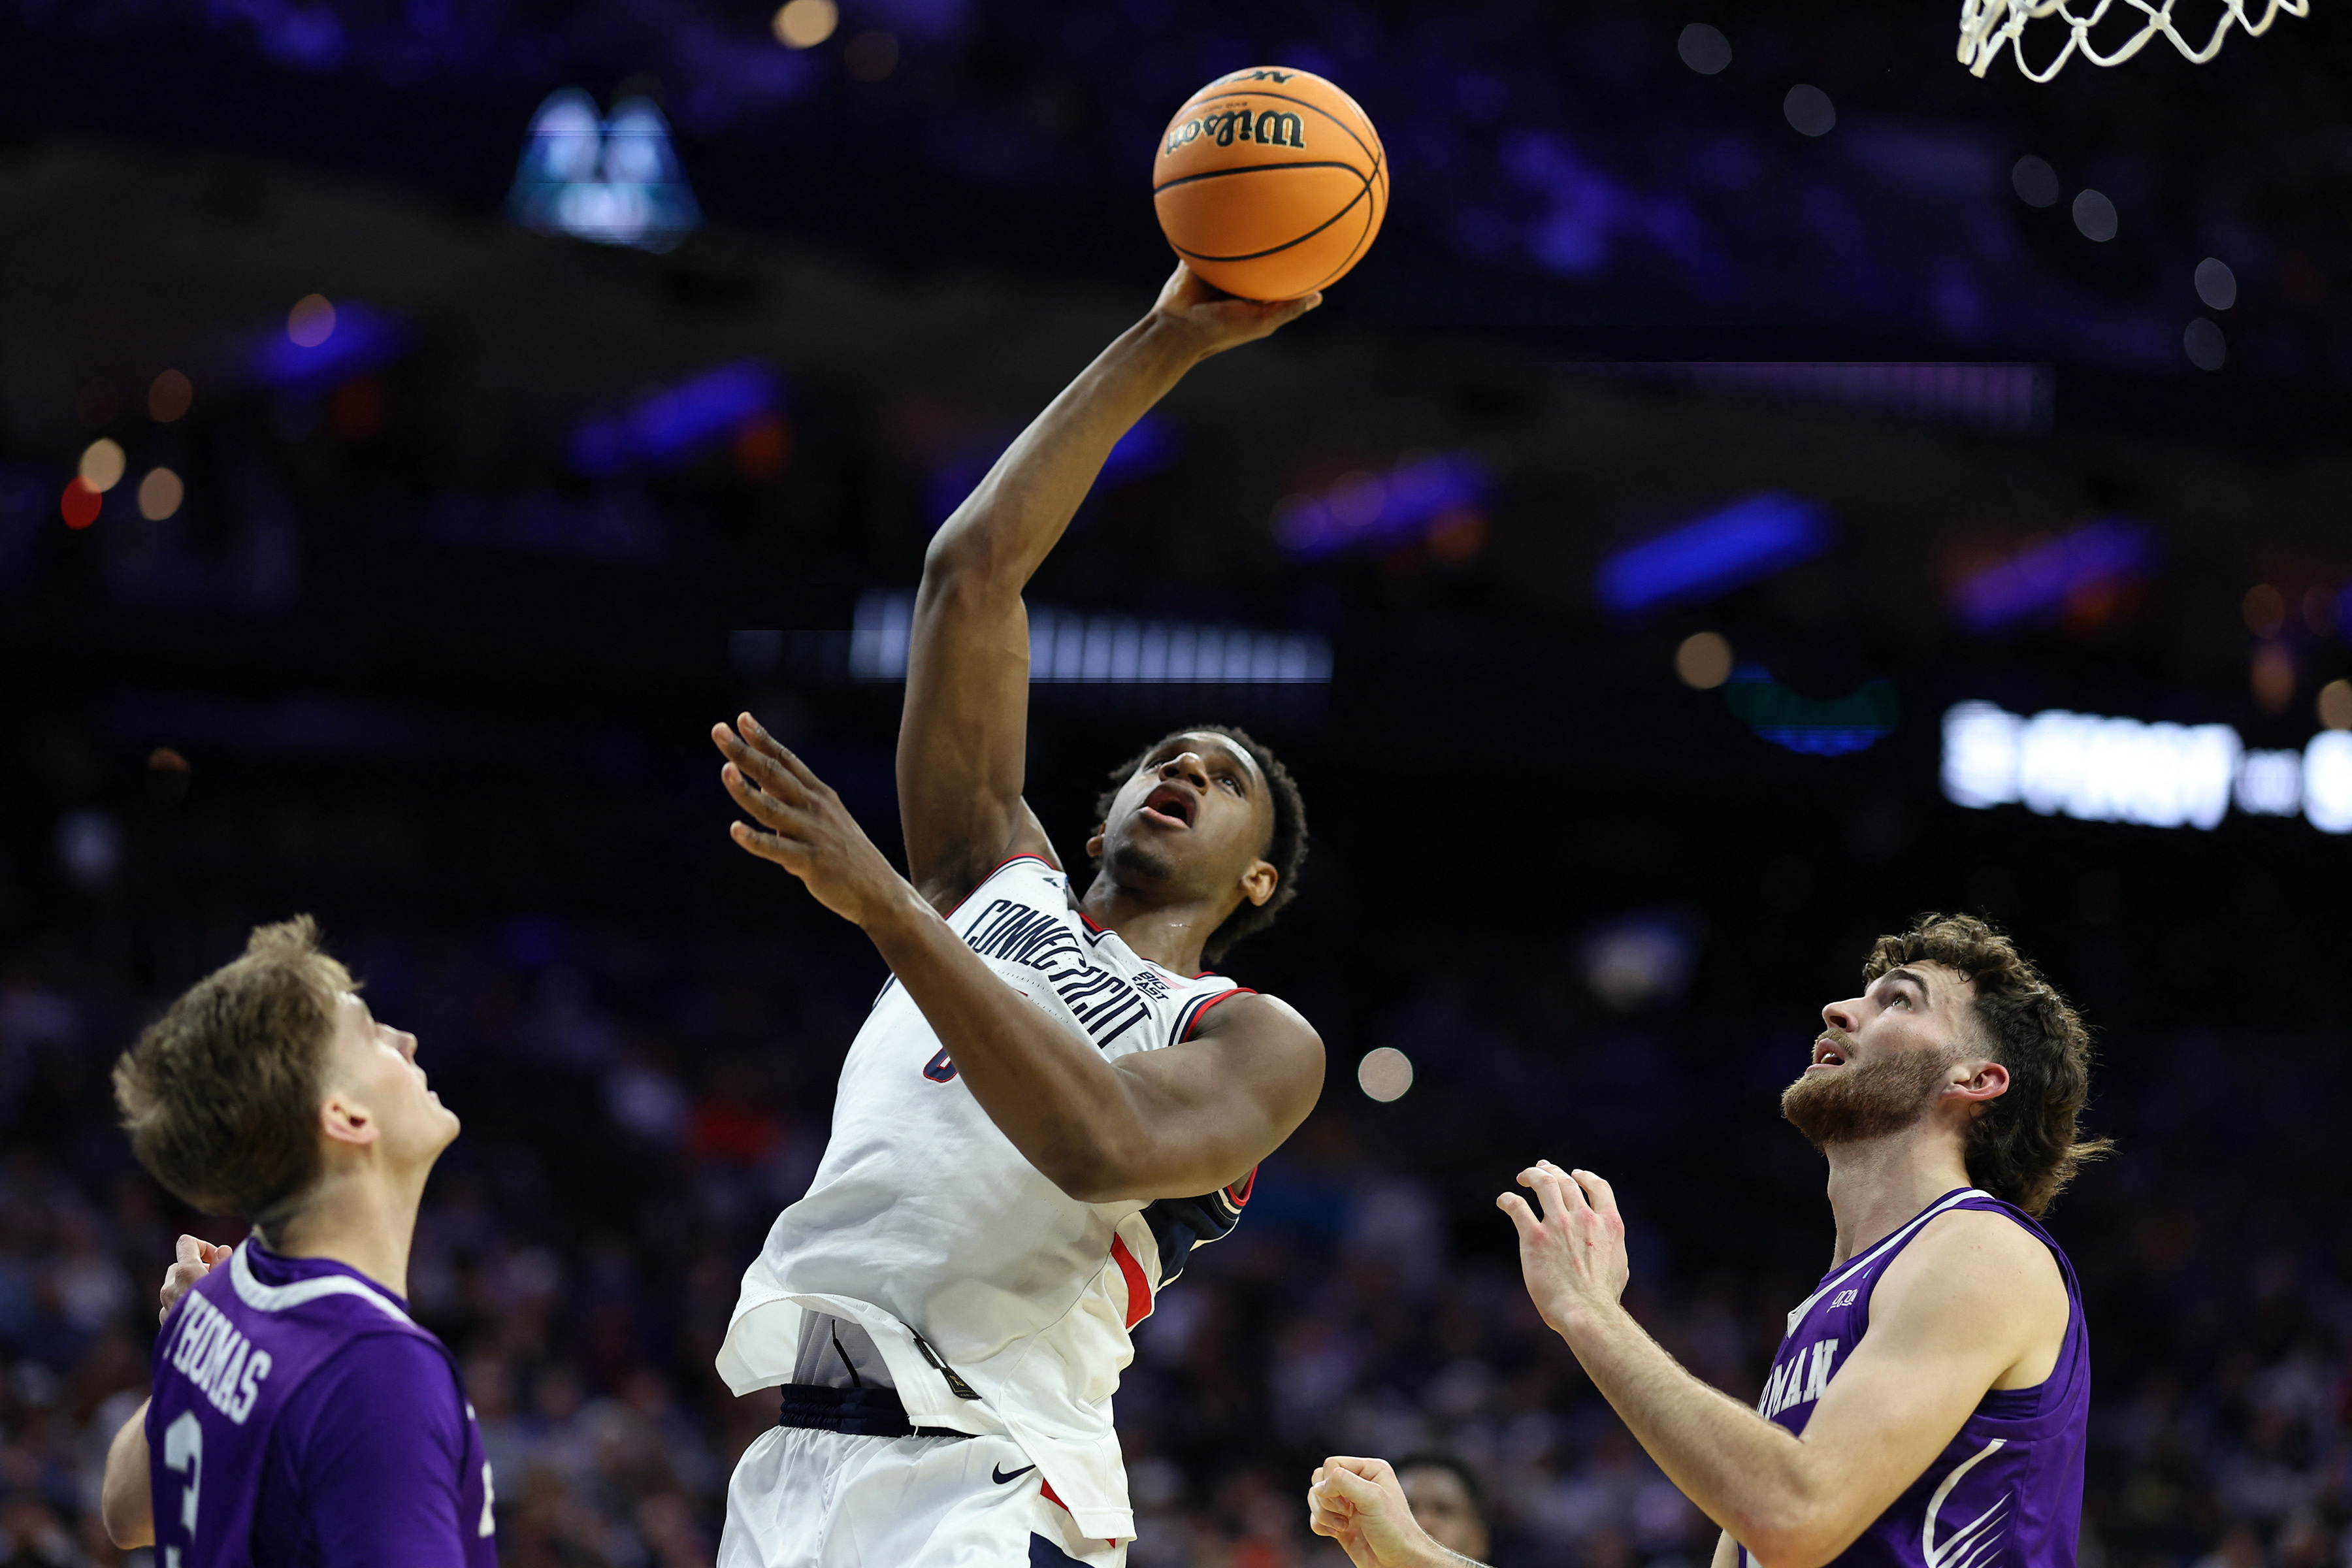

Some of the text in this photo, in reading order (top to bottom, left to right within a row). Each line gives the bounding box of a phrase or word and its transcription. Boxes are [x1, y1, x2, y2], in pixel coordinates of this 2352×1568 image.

[1164, 108, 1306, 157] Wilson
[962, 899, 1152, 1049] CONNECTICUT
[1132, 975, 1169, 1000] EAST
[1137, 971, 1170, 990] BIG
[163, 1288, 272, 1426] THOMAS
[1756, 1337, 1839, 1421] RMAN
